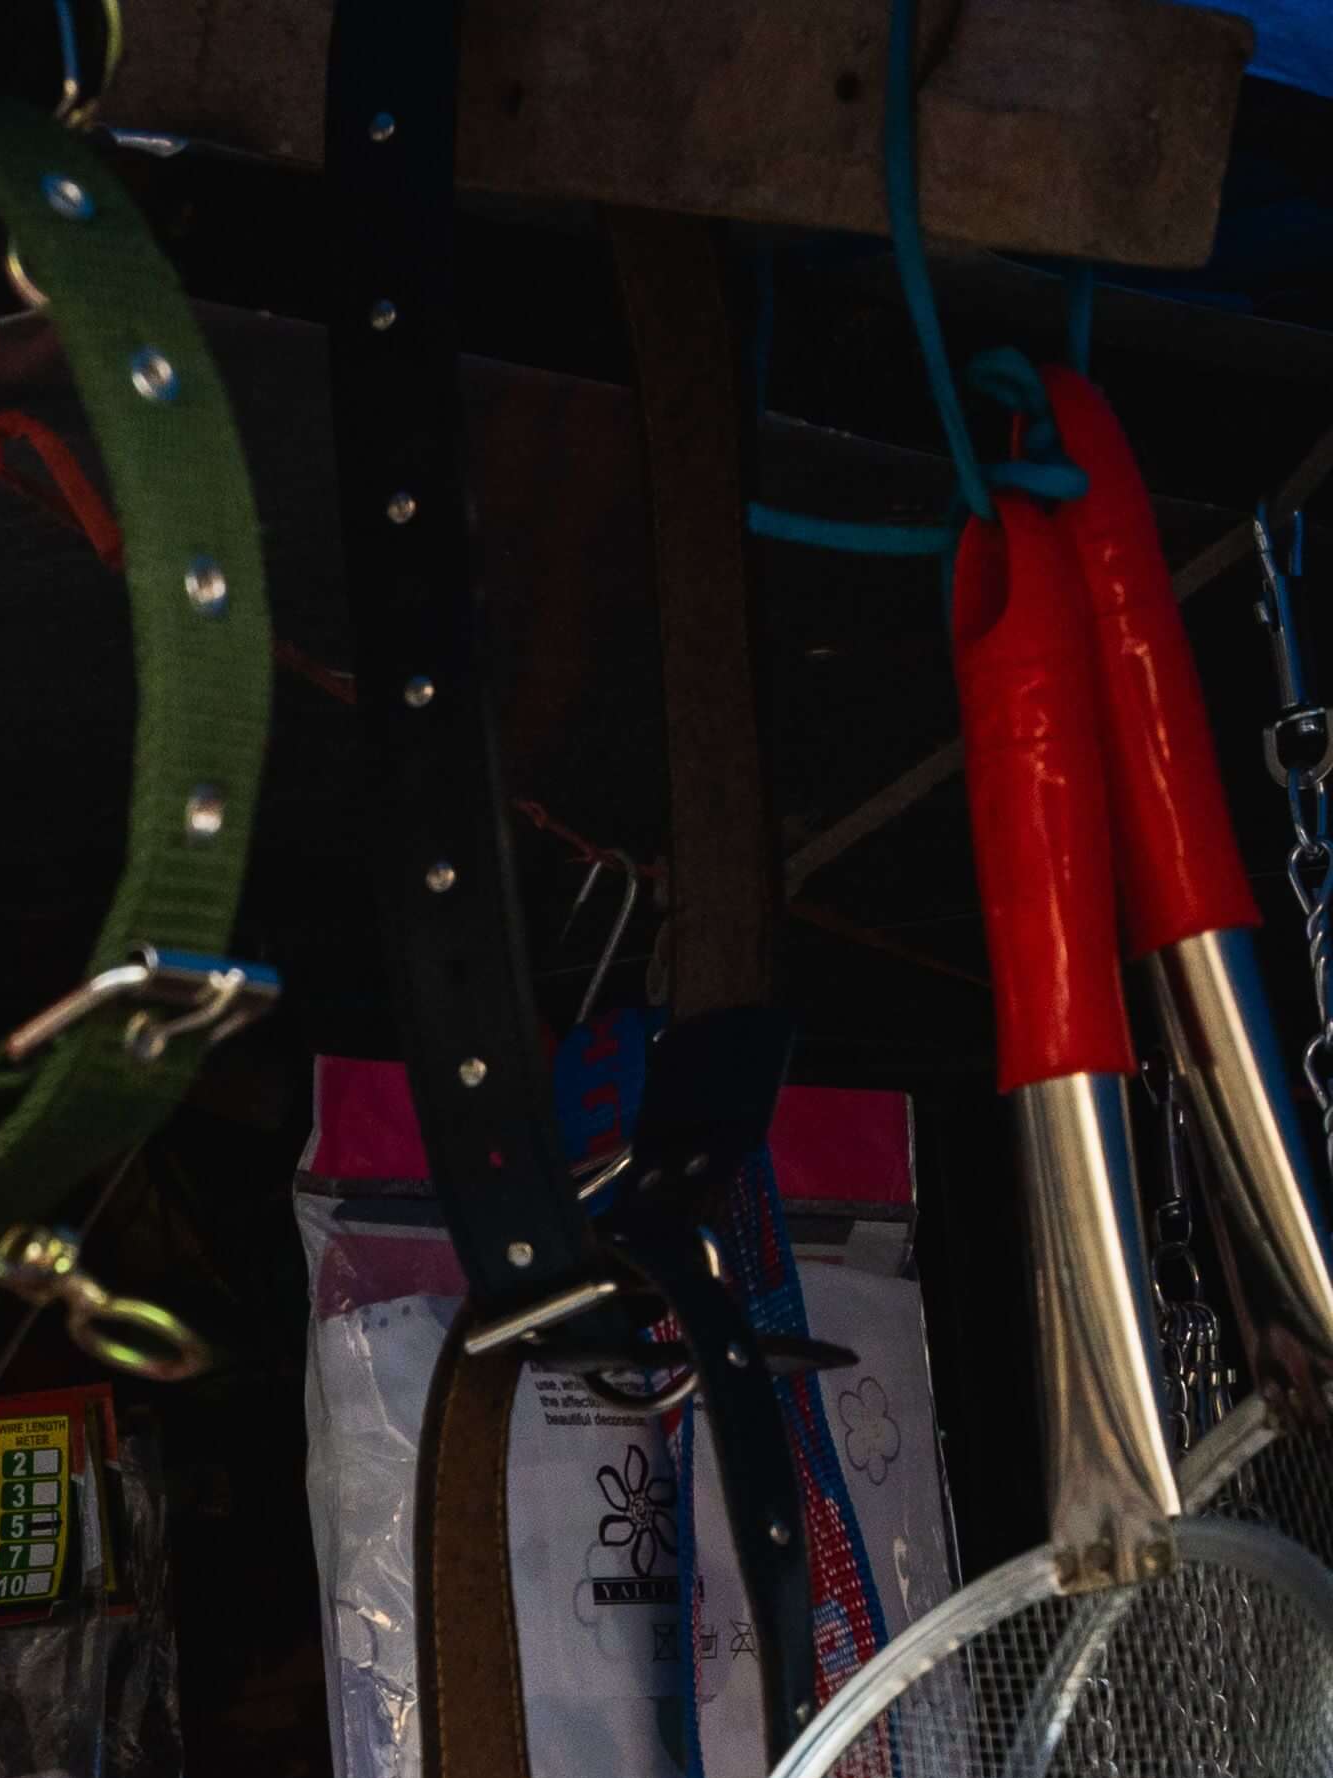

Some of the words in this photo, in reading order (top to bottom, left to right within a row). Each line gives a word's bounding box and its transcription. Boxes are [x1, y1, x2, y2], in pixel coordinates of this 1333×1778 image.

[27, 1420, 66, 1433] LENGTH
[13, 1453, 26, 1475] 2
[12, 1485, 25, 1507] 3
[10, 1515, 24, 1537] 5
[9, 1546, 22, 1568] 7
